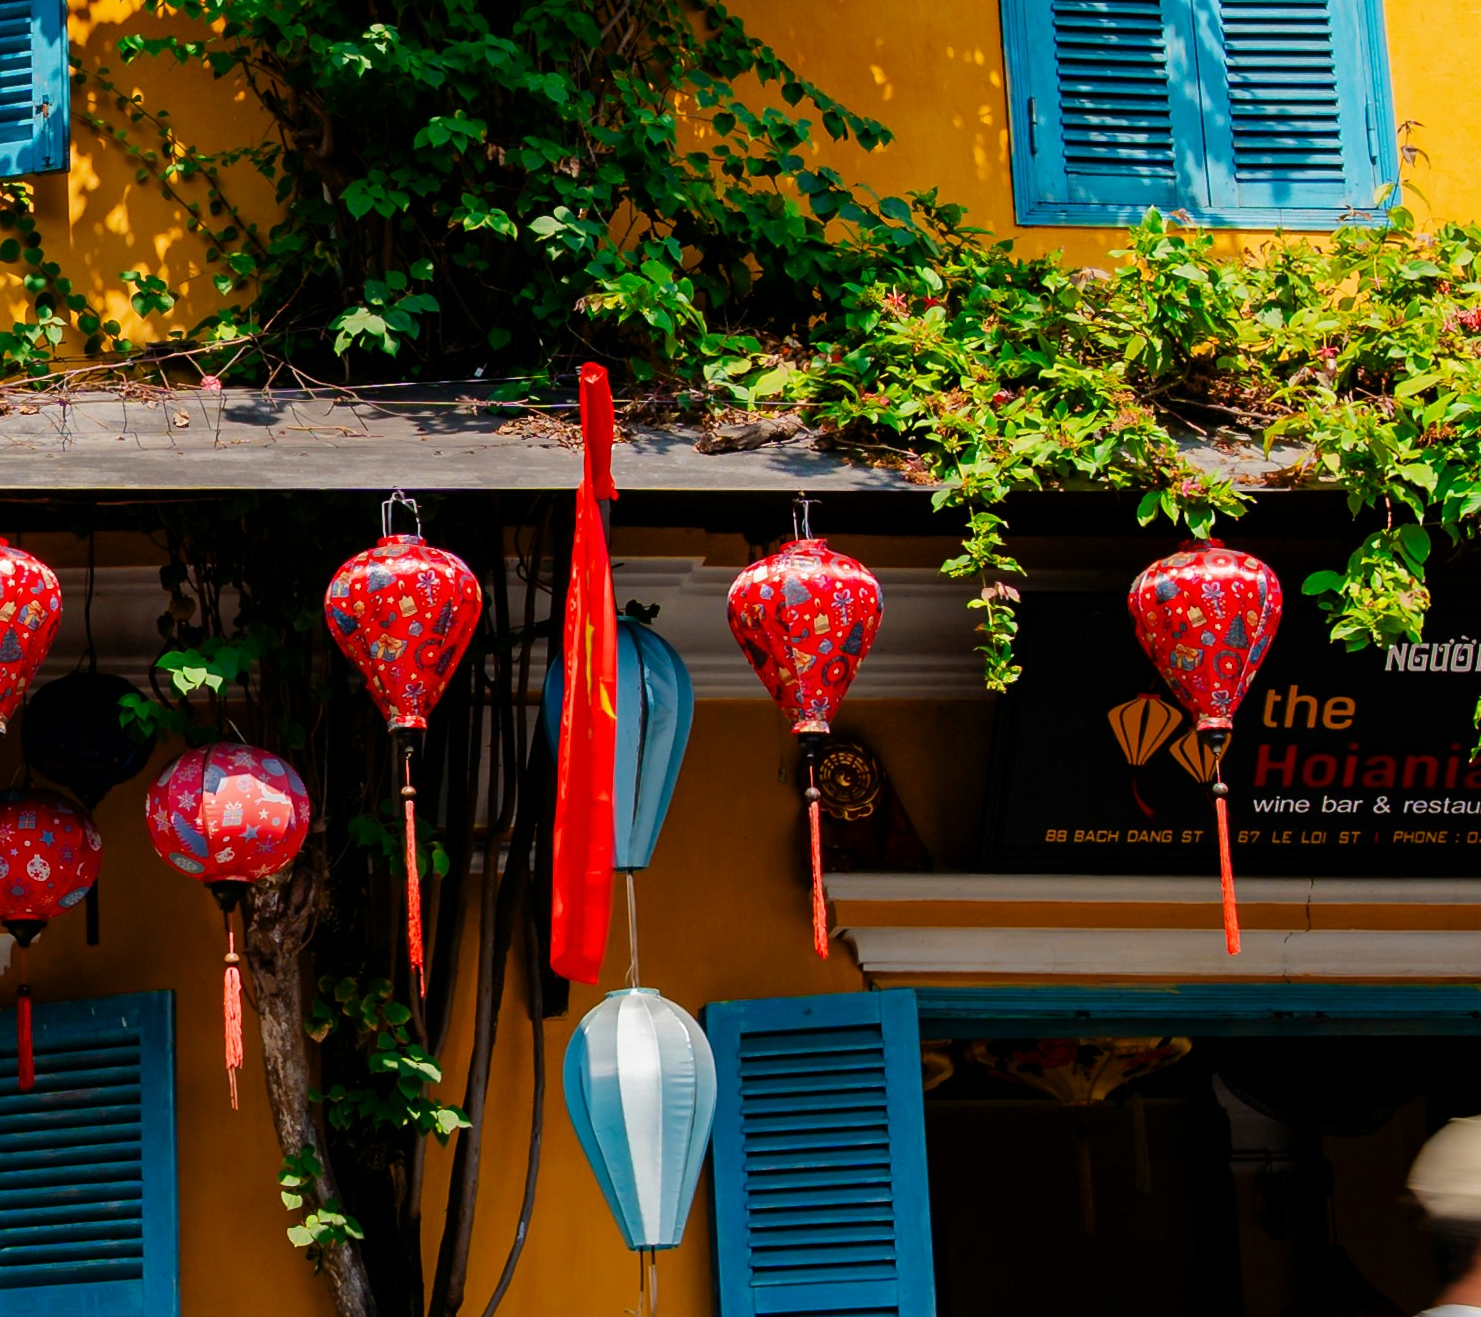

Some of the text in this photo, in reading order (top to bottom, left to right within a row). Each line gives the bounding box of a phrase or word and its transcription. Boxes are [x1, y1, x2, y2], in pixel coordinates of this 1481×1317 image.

[1263, 684, 1356, 730] the
[1253, 795, 1310, 814] wine
[1321, 795, 1363, 814] bar
[1373, 795, 1391, 814] &
[1045, 829, 1068, 843] 88
[1073, 830, 1119, 843] BACH
[1127, 830, 1172, 843] DANG
[1181, 830, 1203, 843] ST
[1237, 830, 1260, 844] 67
[1271, 831, 1292, 844] LE
[1301, 831, 1326, 844] LOI
[1339, 831, 1361, 844] ST
[1393, 831, 1448, 844] PHONE
